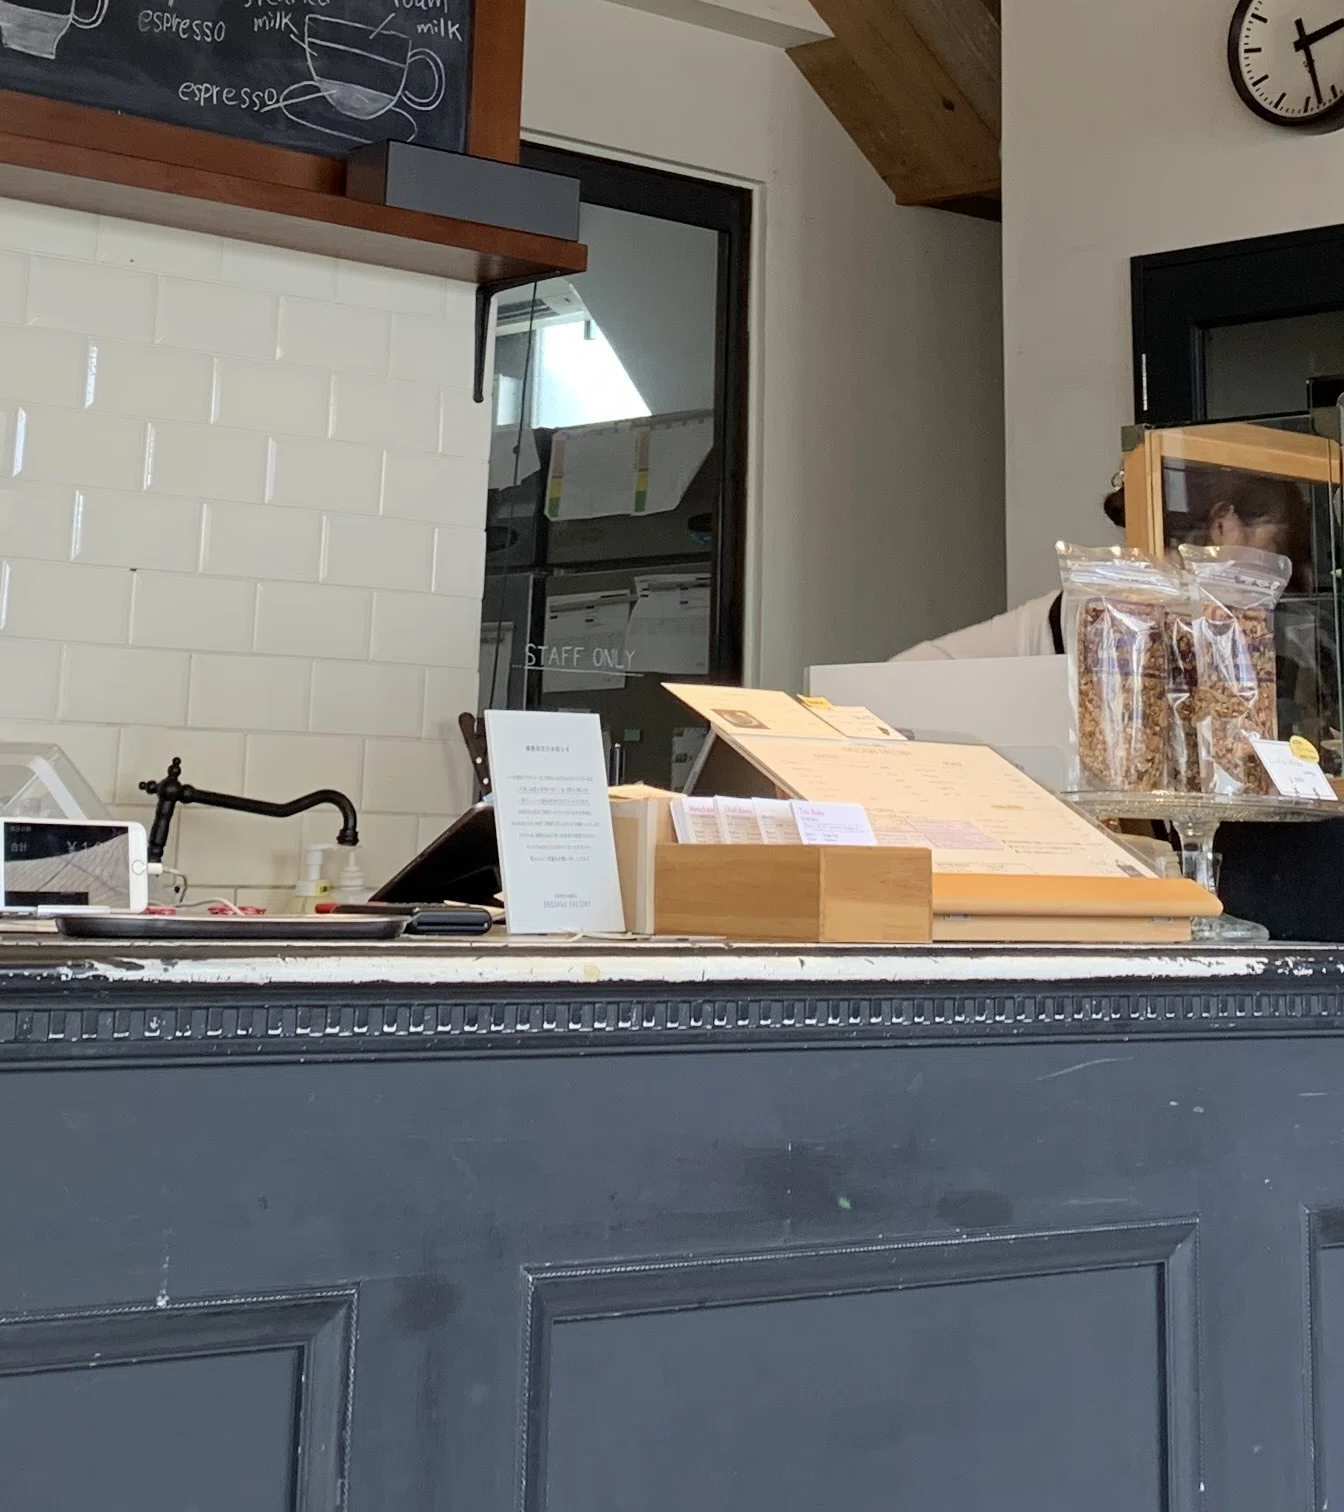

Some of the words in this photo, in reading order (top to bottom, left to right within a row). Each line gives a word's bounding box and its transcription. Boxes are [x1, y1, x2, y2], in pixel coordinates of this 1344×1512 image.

[138, 9, 226, 42] espresso
[254, 11, 299, 35] milk
[416, 17, 463, 42] milk
[178, 81, 278, 112] espresso
[525, 643, 585, 667] STAFF
[593, 648, 636, 670] ONLY
